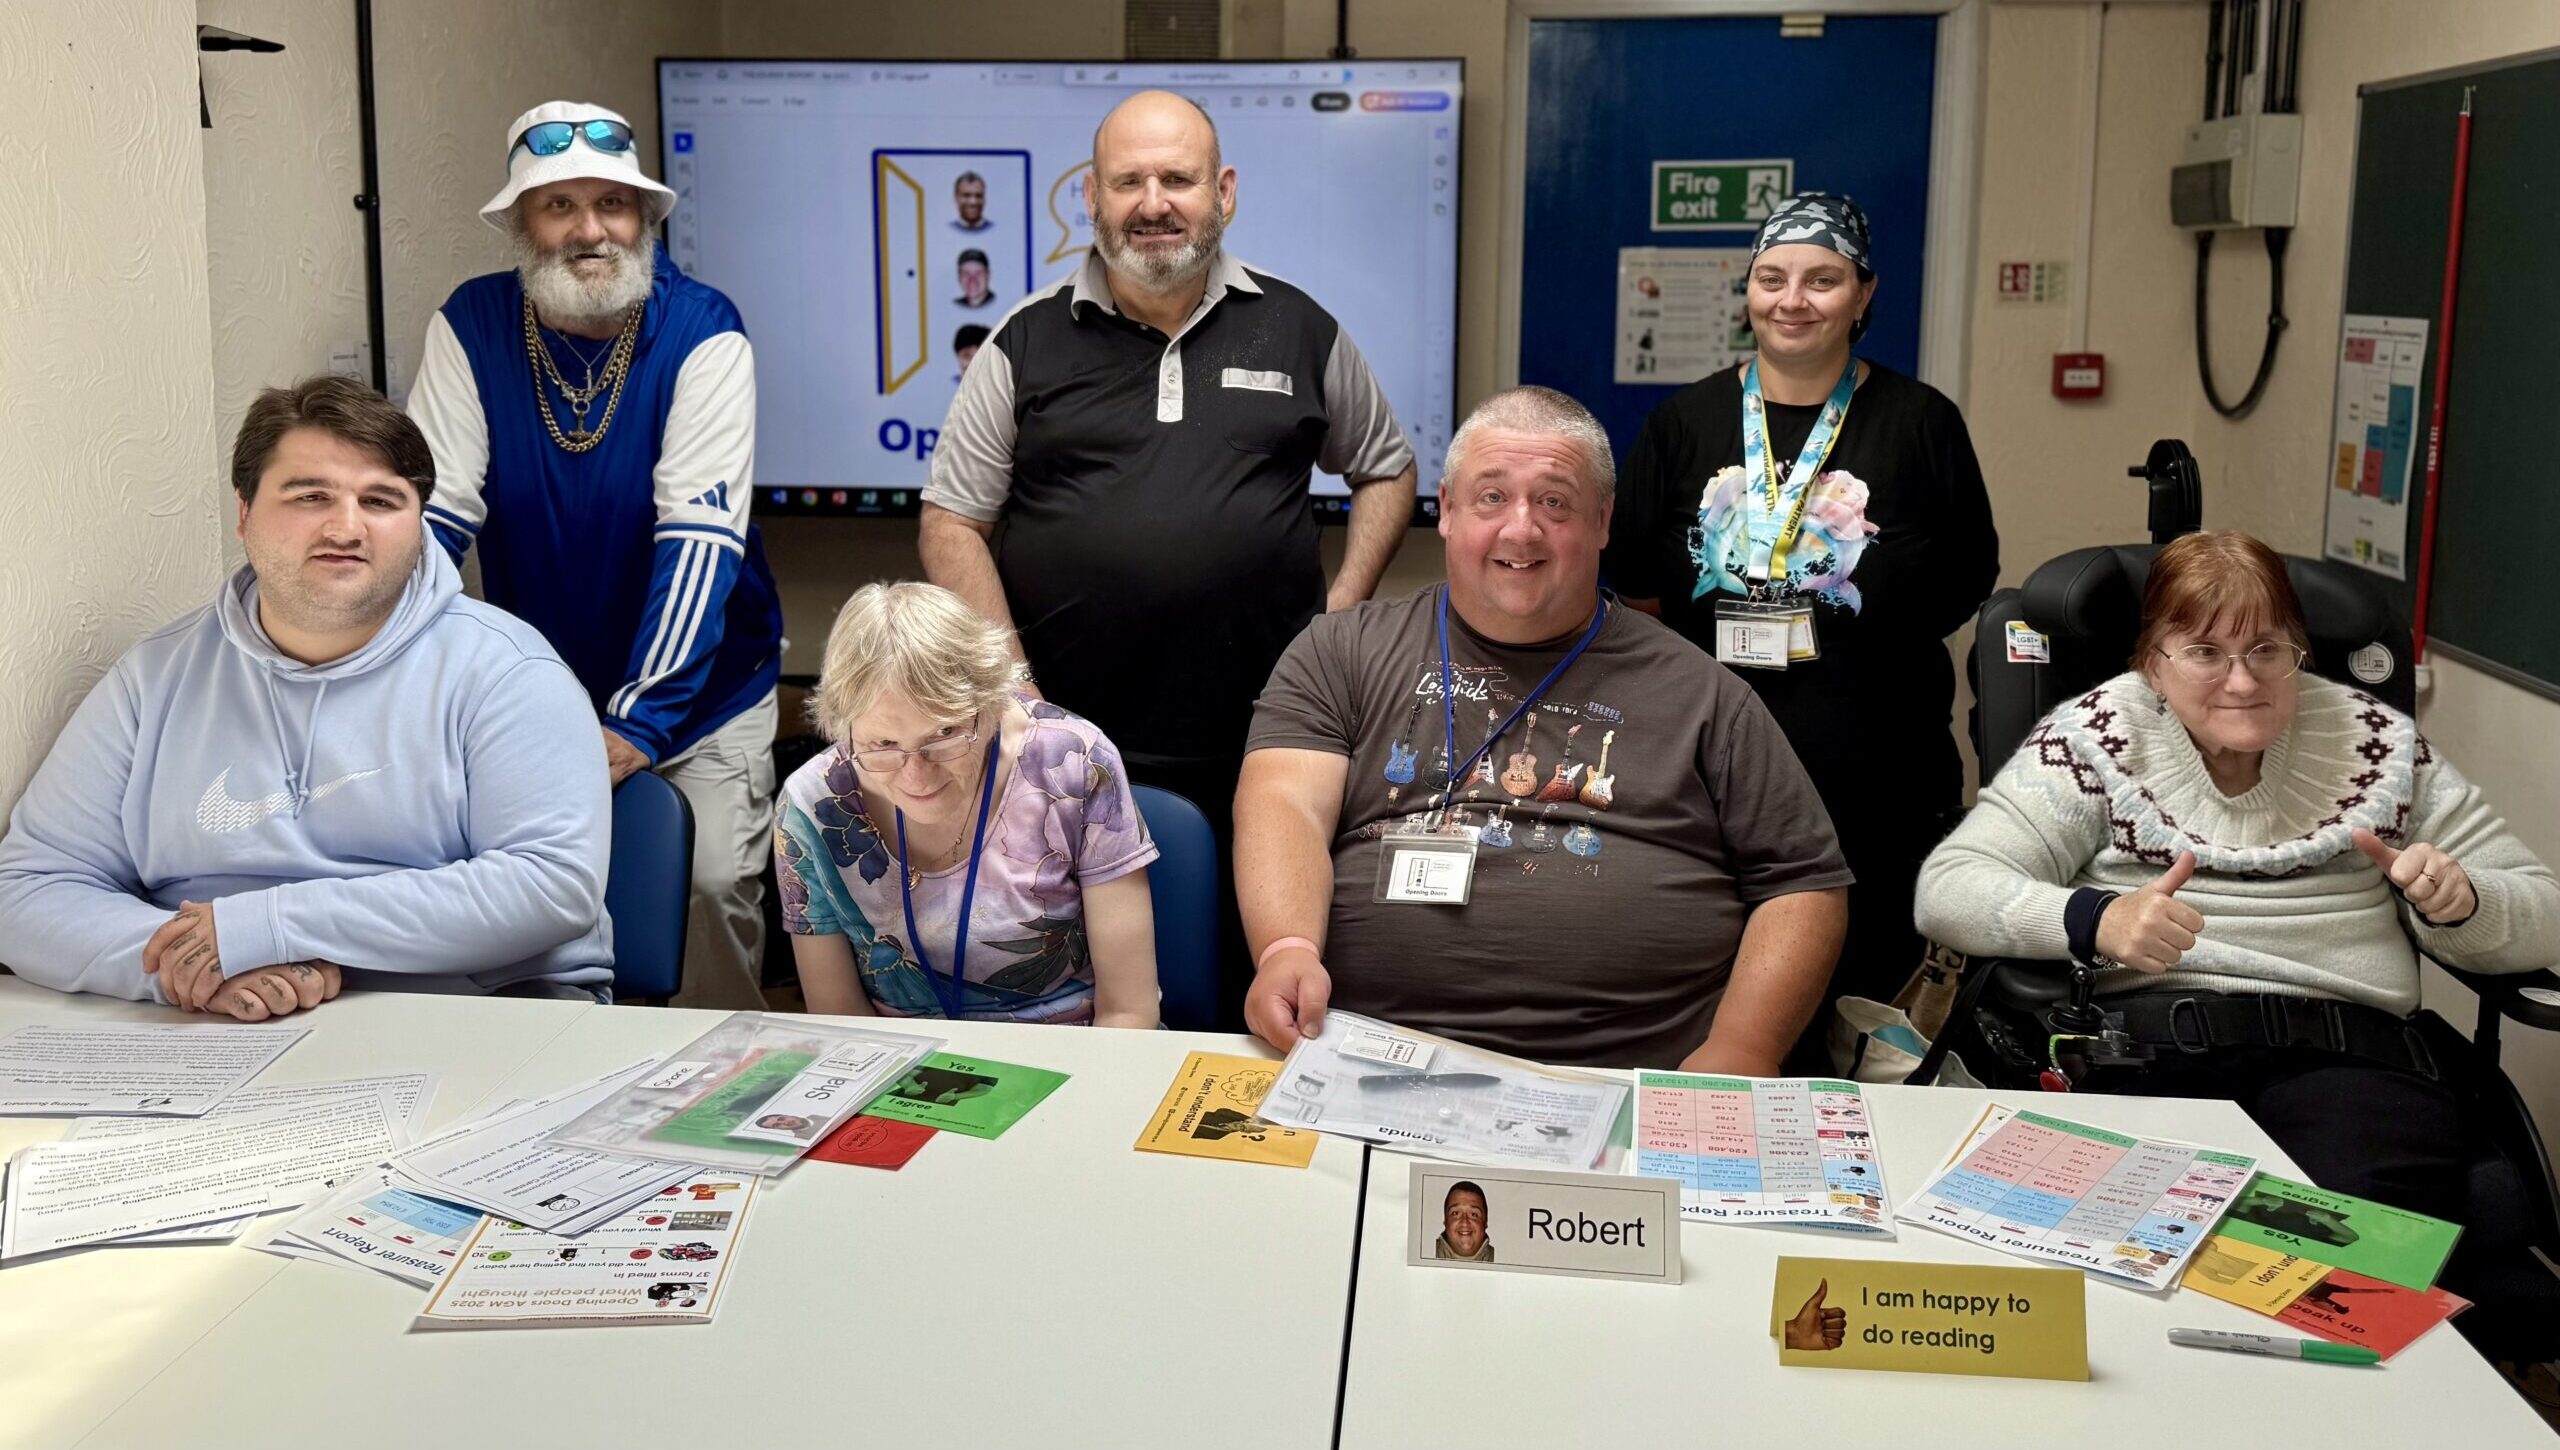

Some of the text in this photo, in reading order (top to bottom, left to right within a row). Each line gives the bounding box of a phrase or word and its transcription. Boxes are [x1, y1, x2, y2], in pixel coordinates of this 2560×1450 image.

[1669, 172, 1721, 195] Fire
[1670, 199, 1719, 219] exit
[1405, 889, 1429, 898] Opening
[949, 1061, 975, 1072] Yes
[1199, 1076, 1215, 1096] don't
[895, 1100, 932, 1109] agree
[1178, 1093, 1205, 1135] understand
[1378, 1127, 1442, 1144] Agenda
[1649, 1140, 1687, 1148] £30,337
[1708, 1146, 1747, 1154] £20,408
[1973, 1163, 2013, 1177] £30,337
[2033, 1181, 2074, 1193] £20,408
[2281, 1191, 2327, 1212] agree
[1529, 1208, 1644, 1246] Robert
[2263, 1225, 2301, 1246] Yes
[1928, 1214, 2101, 1266] Treasurer Report
[322, 1227, 445, 1275] Treasurer Report
[461, 1287, 642, 1298] What people thought
[576, 1297, 638, 1305] Opening
[1862, 1286, 2030, 1316] I am happy to
[2289, 1303, 2365, 1333] peak up
[1863, 1324, 1994, 1354] do reading
